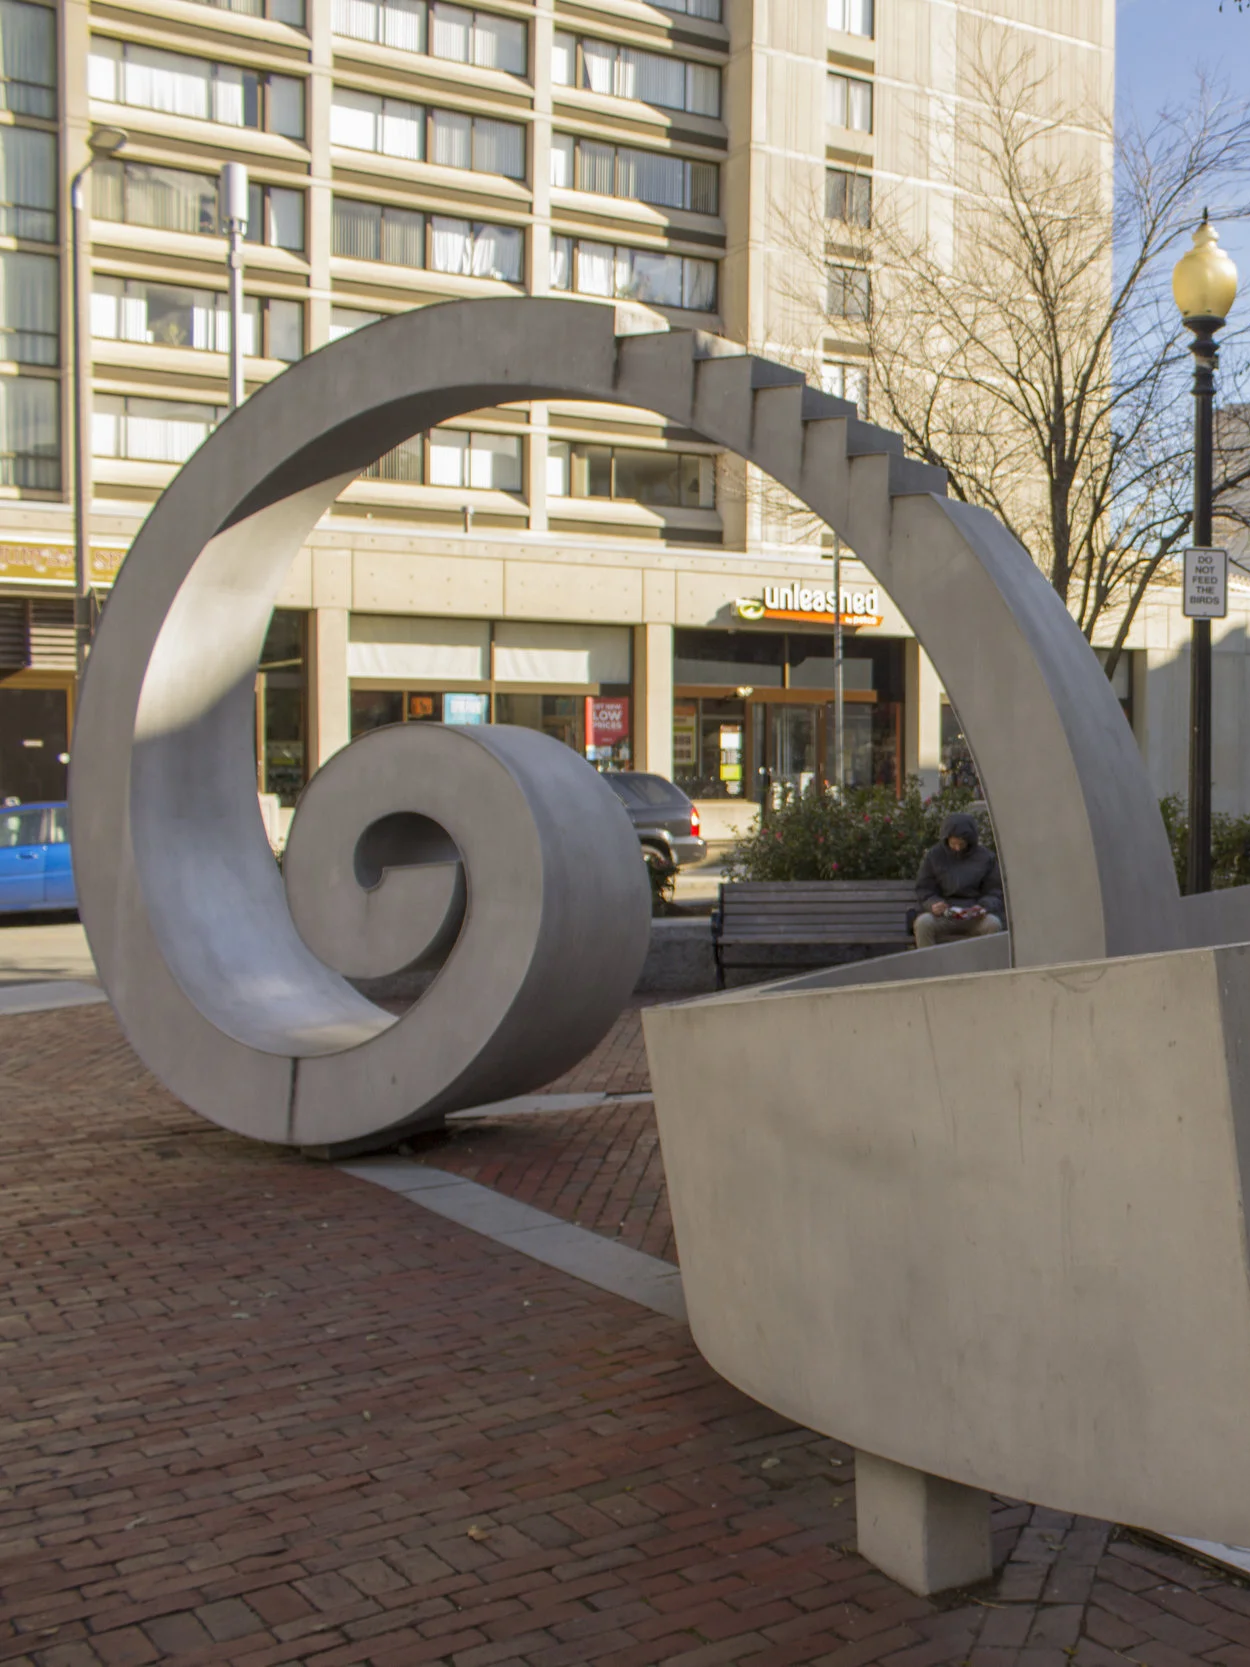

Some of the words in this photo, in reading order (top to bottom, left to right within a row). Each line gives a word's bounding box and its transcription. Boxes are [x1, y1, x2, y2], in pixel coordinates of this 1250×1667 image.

[1197, 556, 1213, 565] DO
[1195, 566, 1215, 574] NOT
[1192, 576, 1218, 585] FEED
[1196, 586, 1215, 594] THE
[764, 584, 879, 616] unleashed
[1190, 596, 1220, 606] BIRDS
[592, 711, 623, 721] LOW
[592, 721, 623, 730] PRICES
